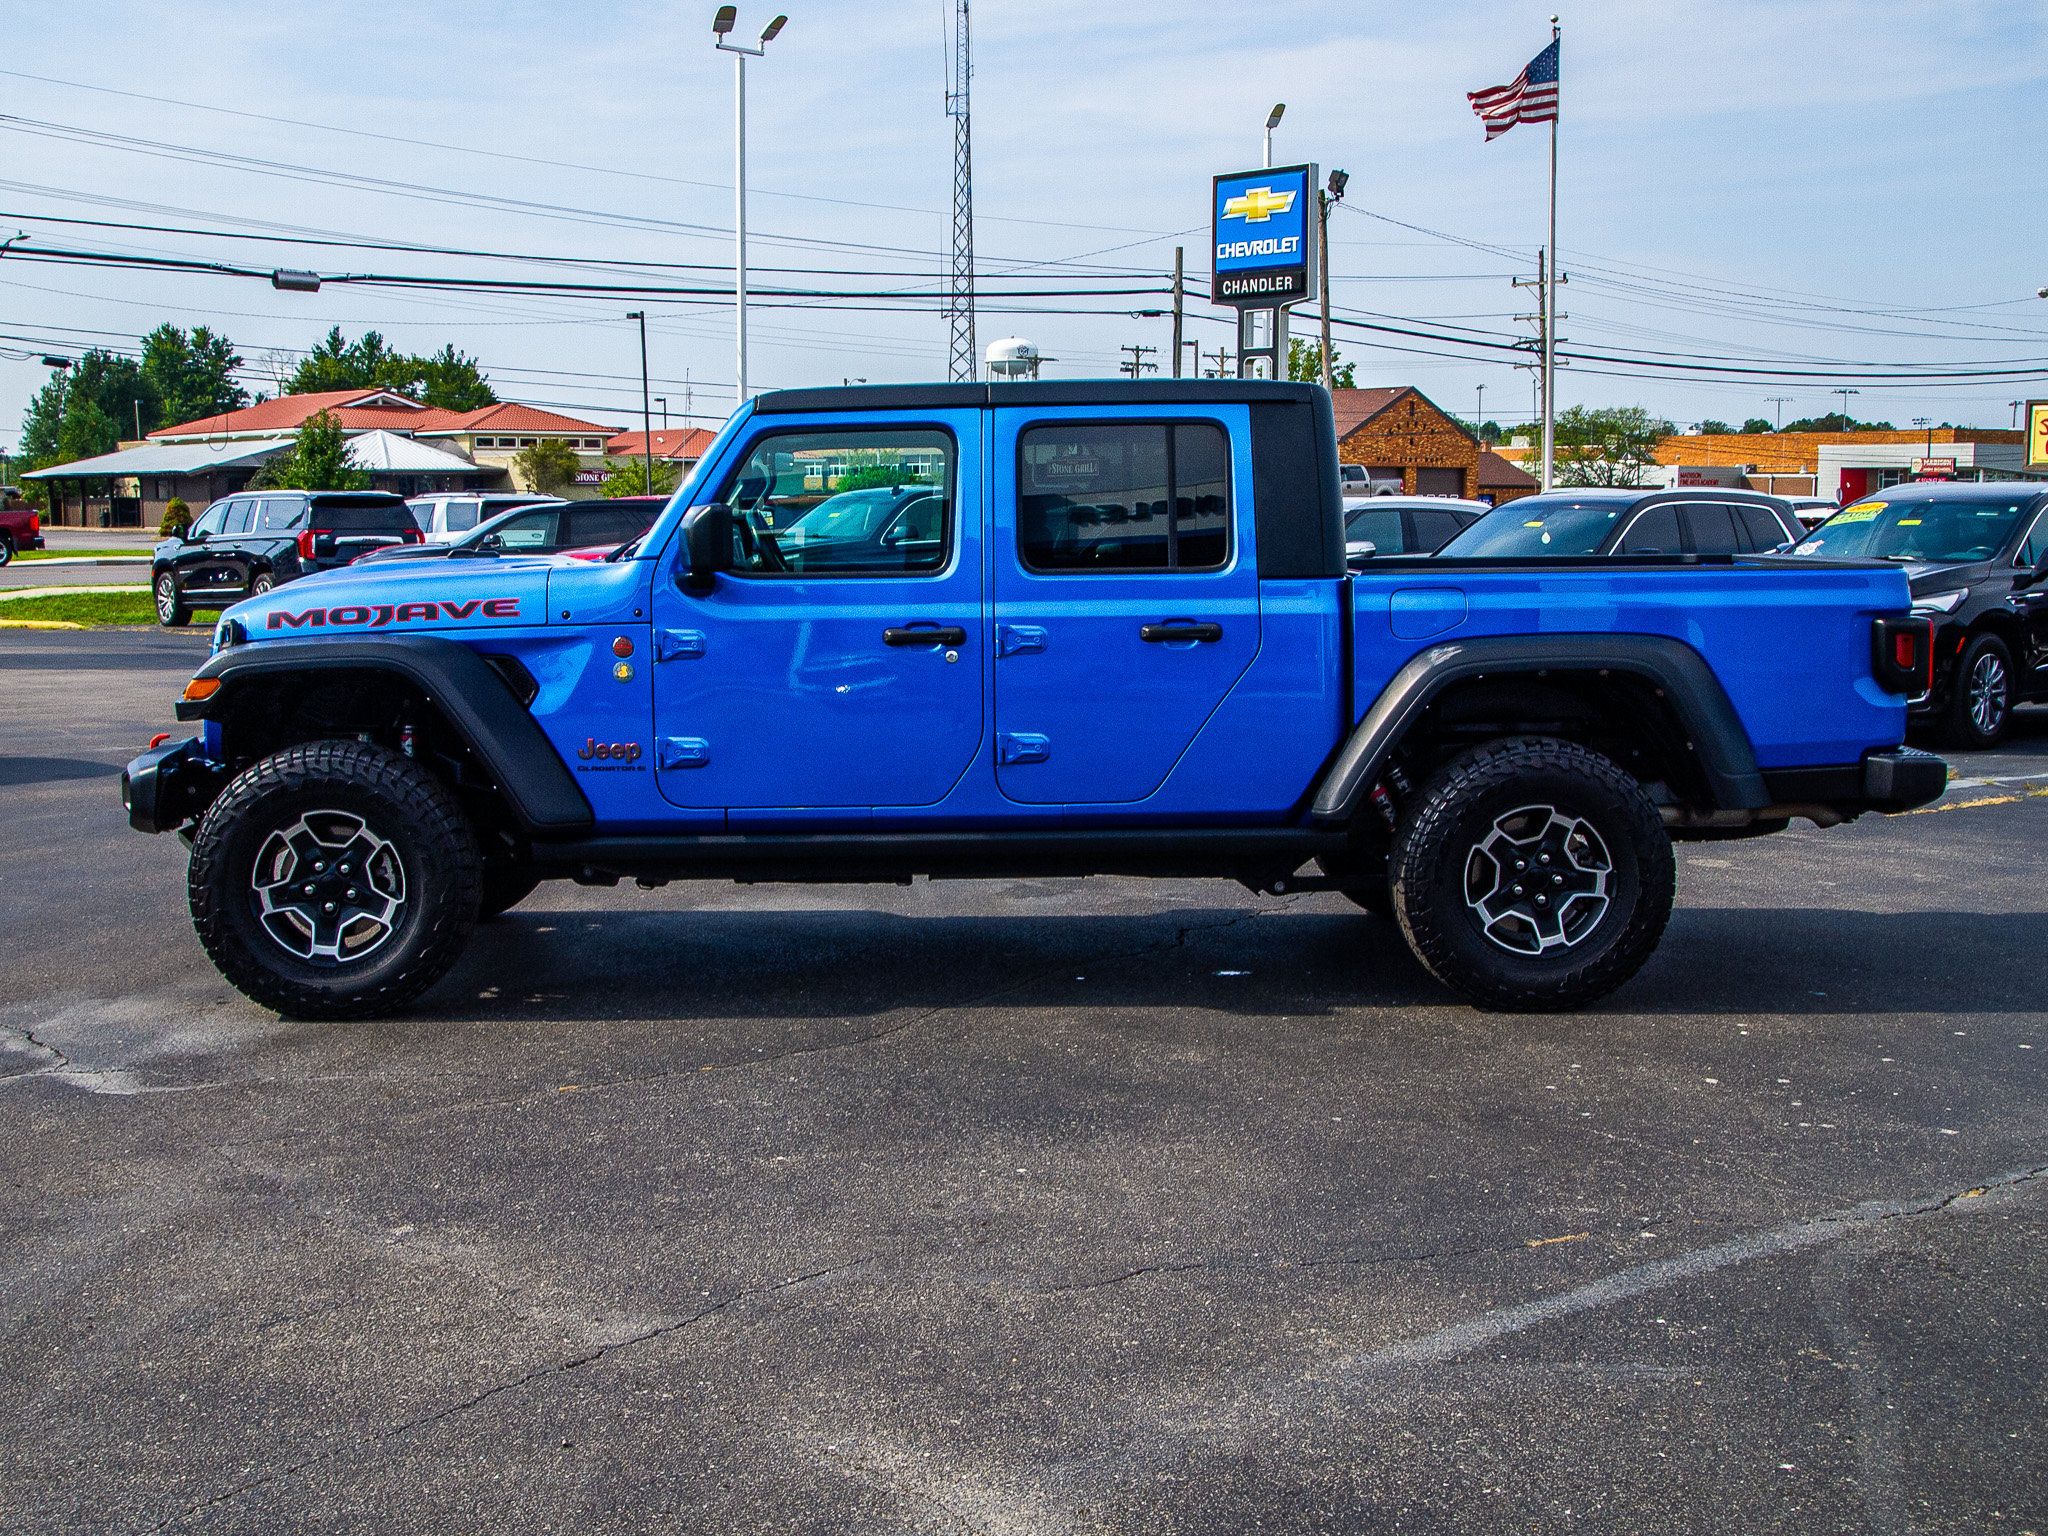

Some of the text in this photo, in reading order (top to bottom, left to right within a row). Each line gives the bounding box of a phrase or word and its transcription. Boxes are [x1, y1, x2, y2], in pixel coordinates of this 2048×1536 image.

[1217, 236, 1300, 259] CHEVROLET
[1222, 276, 1293, 294] CHANDLER
[575, 473, 600, 482] STONE
[267, 598, 520, 630] MOJAVE
[578, 738, 642, 764] Jeep
